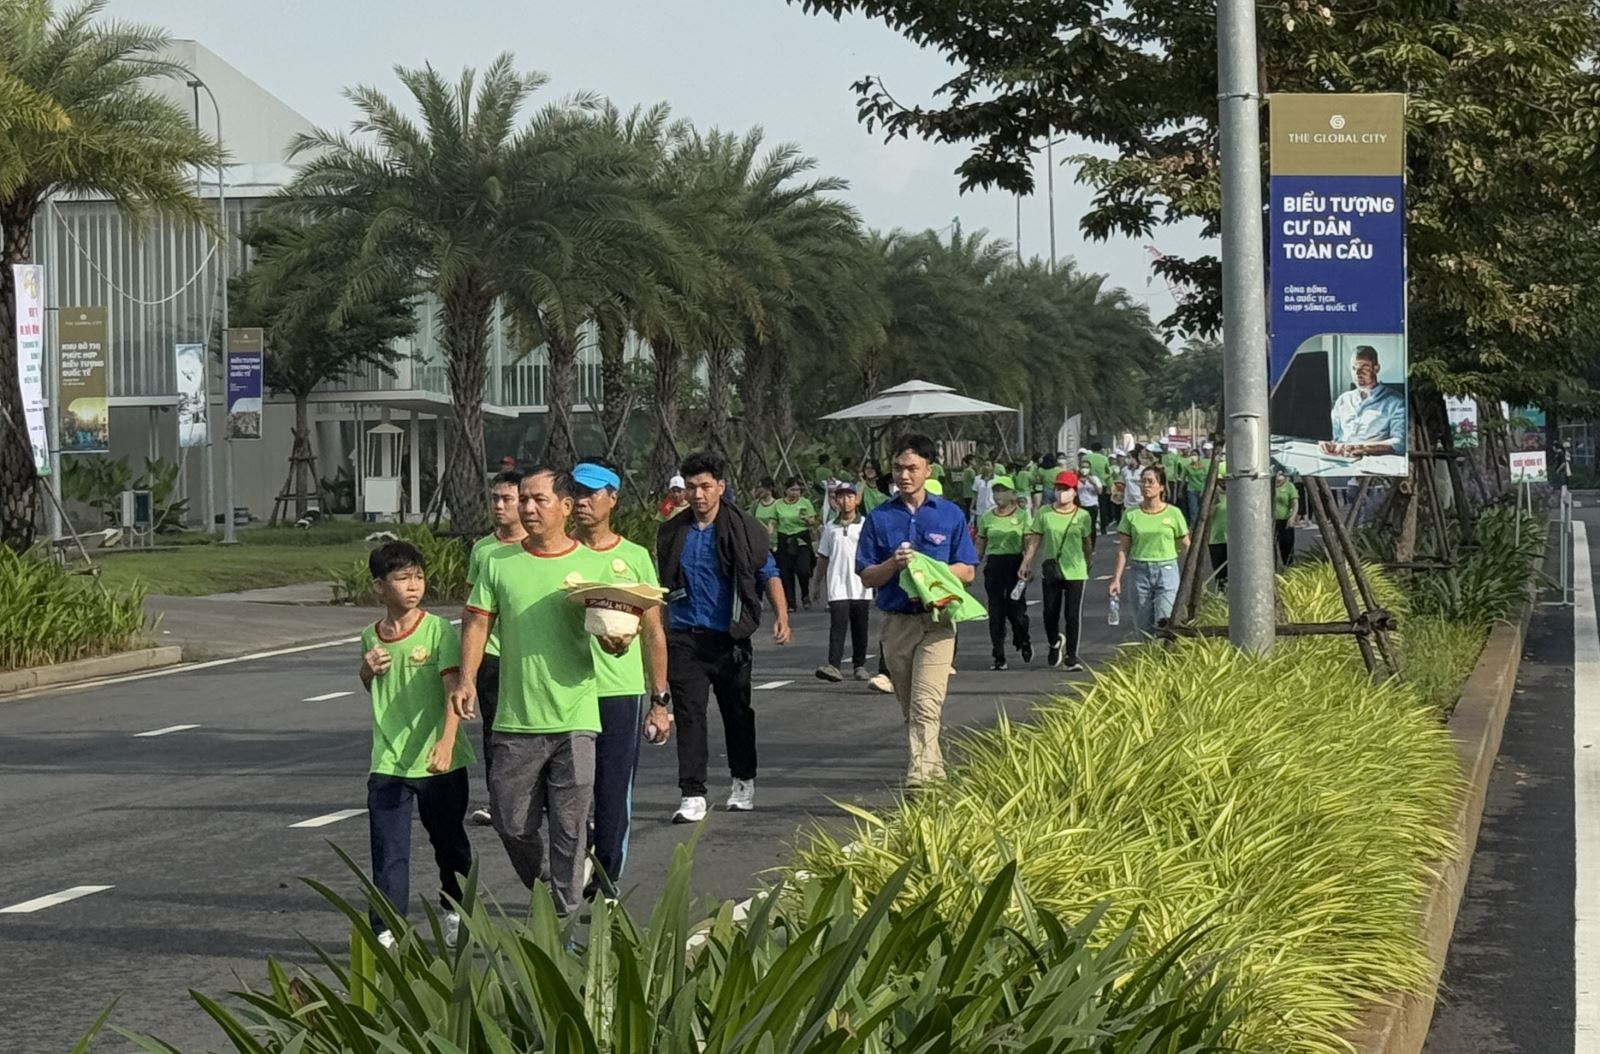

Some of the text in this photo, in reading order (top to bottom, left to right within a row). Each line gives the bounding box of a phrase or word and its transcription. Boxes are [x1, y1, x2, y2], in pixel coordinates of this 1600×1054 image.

[1289, 133, 1387, 143] THE GLOBAL CITY
[1283, 190, 1394, 217] BIỂU TƯỢNG
[1282, 215, 1351, 236] CƯ DÂN
[1282, 237, 1373, 259] TOÀN CẦU
